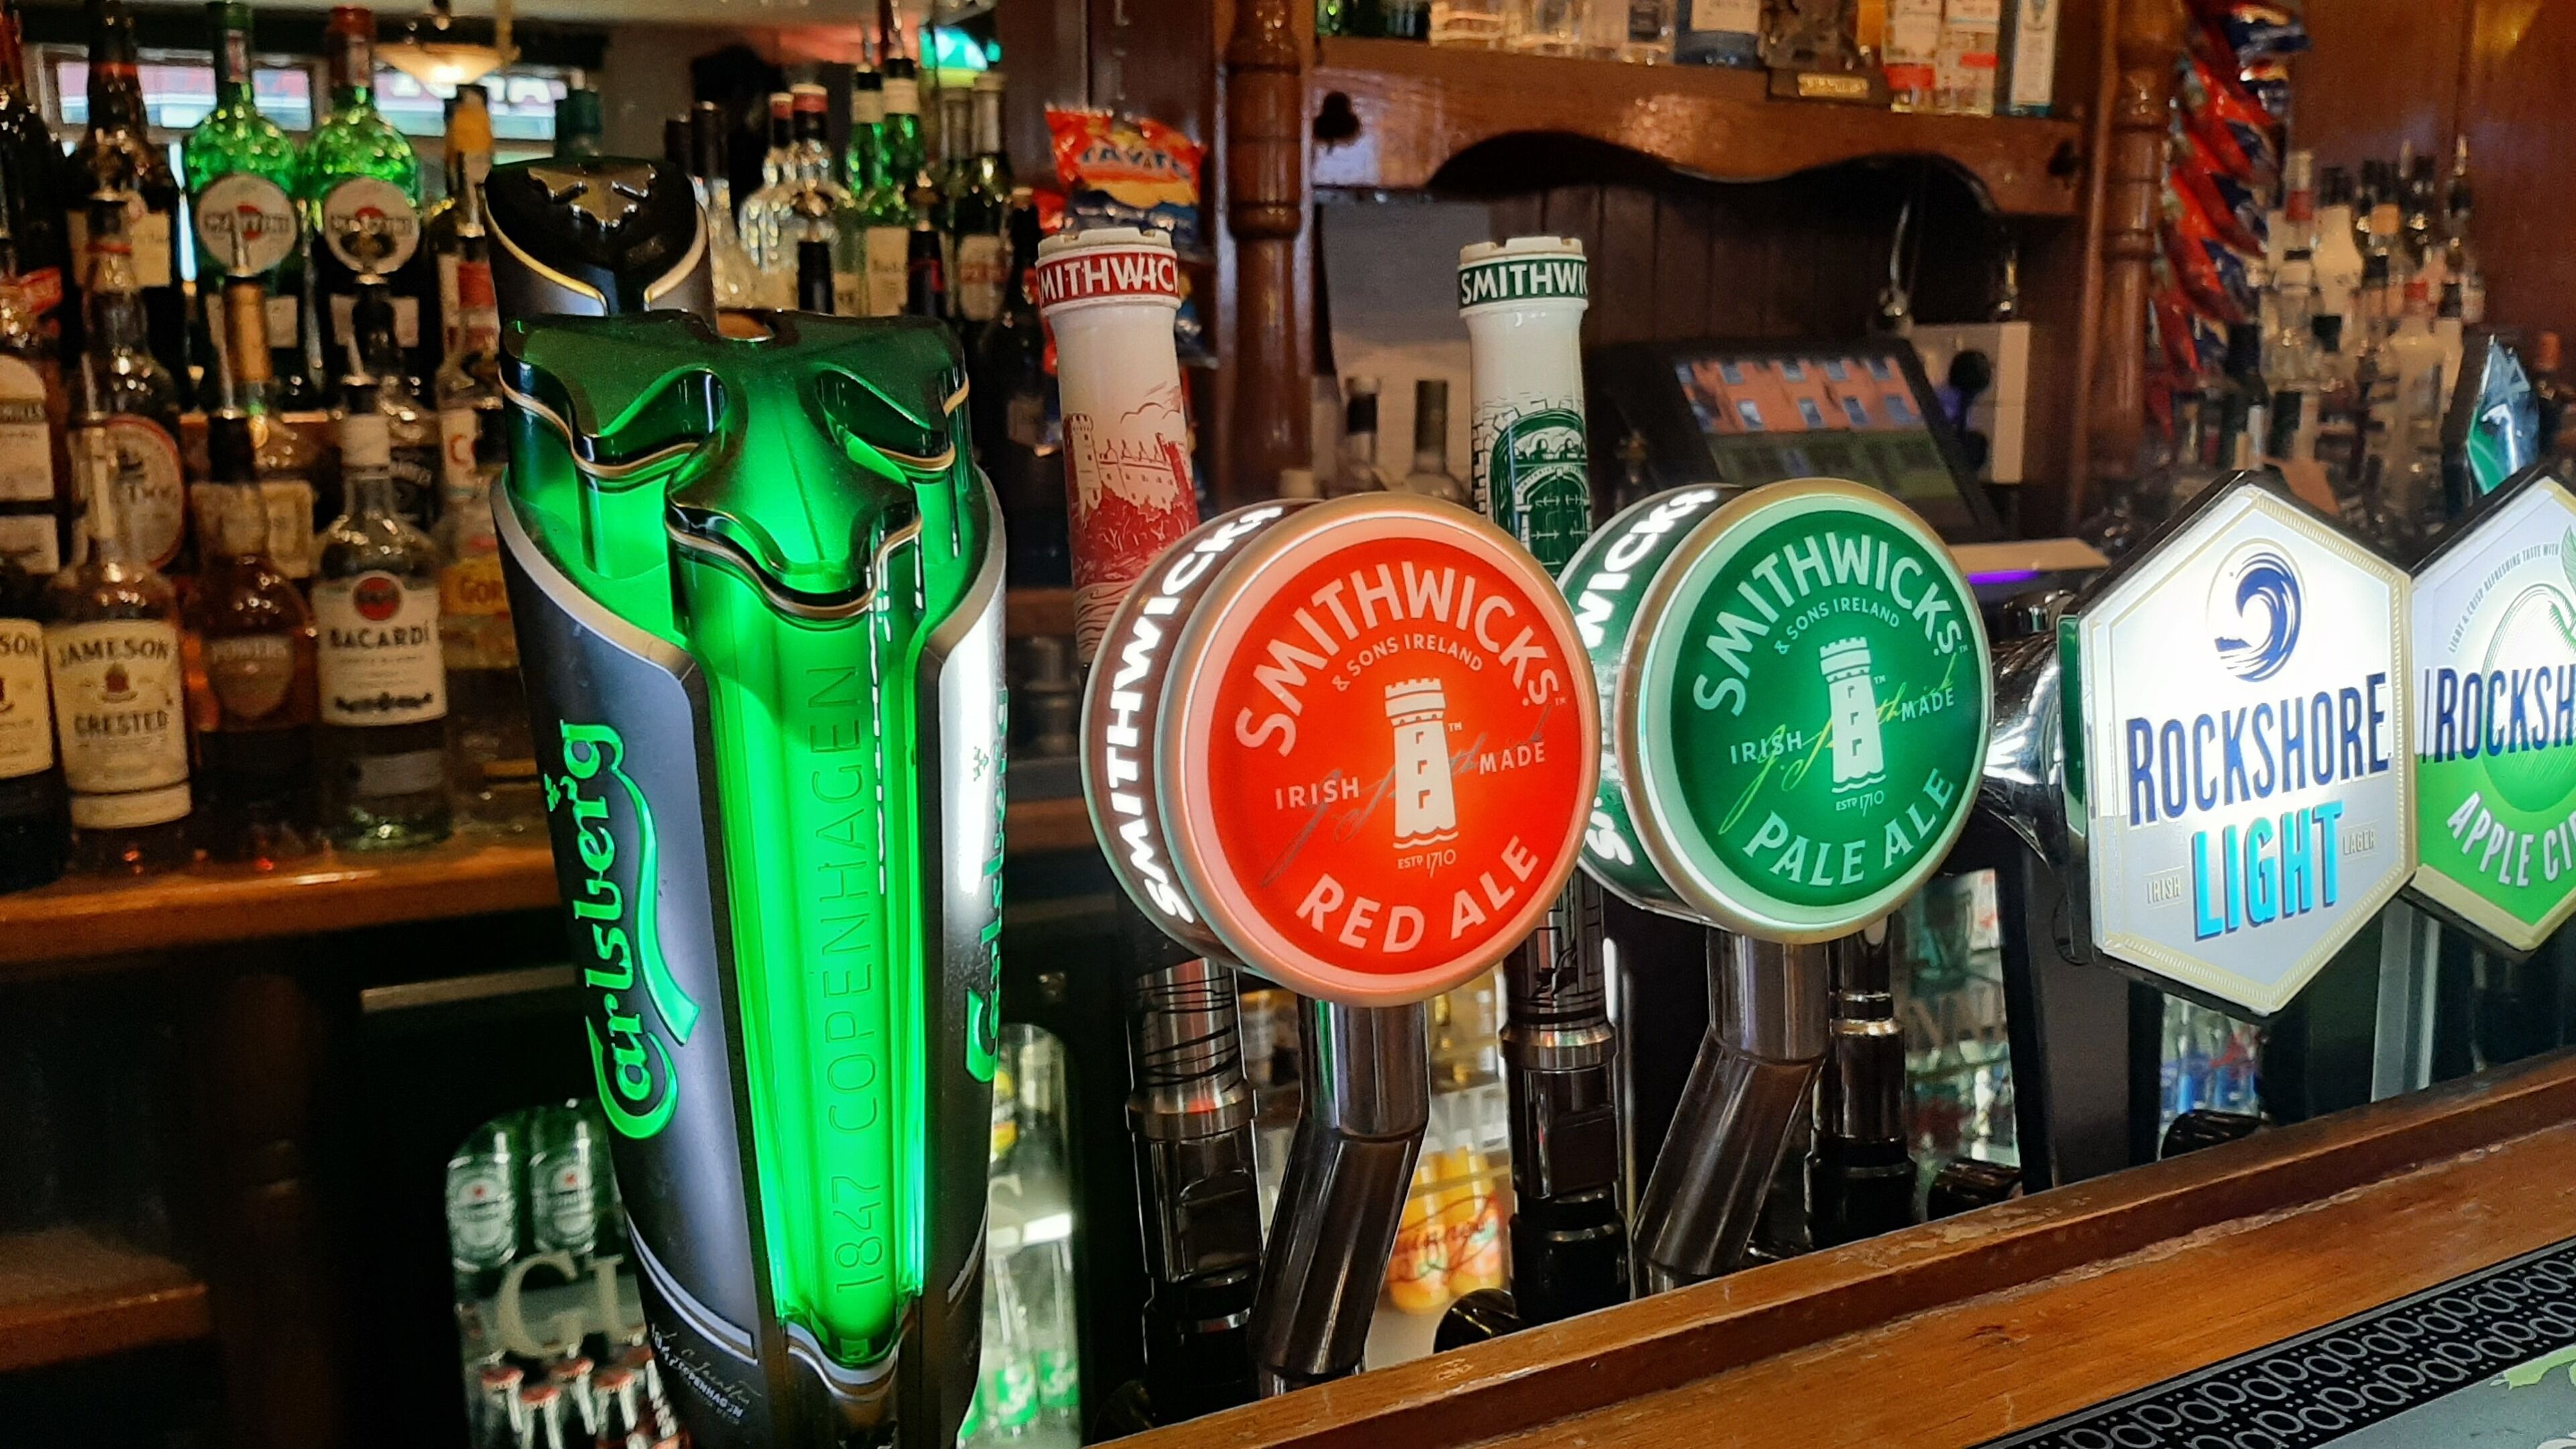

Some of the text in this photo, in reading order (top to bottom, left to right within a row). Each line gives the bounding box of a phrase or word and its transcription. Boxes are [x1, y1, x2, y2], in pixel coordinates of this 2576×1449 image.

[2467, 588, 2484, 616] CRISP
[2483, 553, 2522, 592] REFRESHING
[2521, 544, 2541, 562] TASTE
[1786, 601, 1830, 640] SONS
[1833, 596, 1900, 629] IRELAND
[58, 637, 168, 667] JAMESON
[1346, 636, 1399, 677] SONS
[1403, 633, 1484, 672] IRELAND
[1901, 688, 1955, 722] MADE
[1479, 741, 1546, 775] MADE
[1730, 731, 1803, 765] IRISH
[2125, 672, 2389, 827] ROCKSHORE
[1275, 776, 1360, 810] IRISH
[1859, 790, 1884, 817] 1710
[1743, 767, 1956, 887] PALE ALE
[2342, 830, 2375, 857] LAGER
[2447, 790, 2535, 887] APPLE
[1426, 848, 1457, 879] 1710
[2192, 799, 2345, 943] LIGHT
[1295, 835, 1540, 954] RED ALE
[2145, 874, 2180, 904] IRISH
[559, 719, 701, 1139] Carlsberg
[808, 665, 884, 1294] 1847 COPENHAGEN
